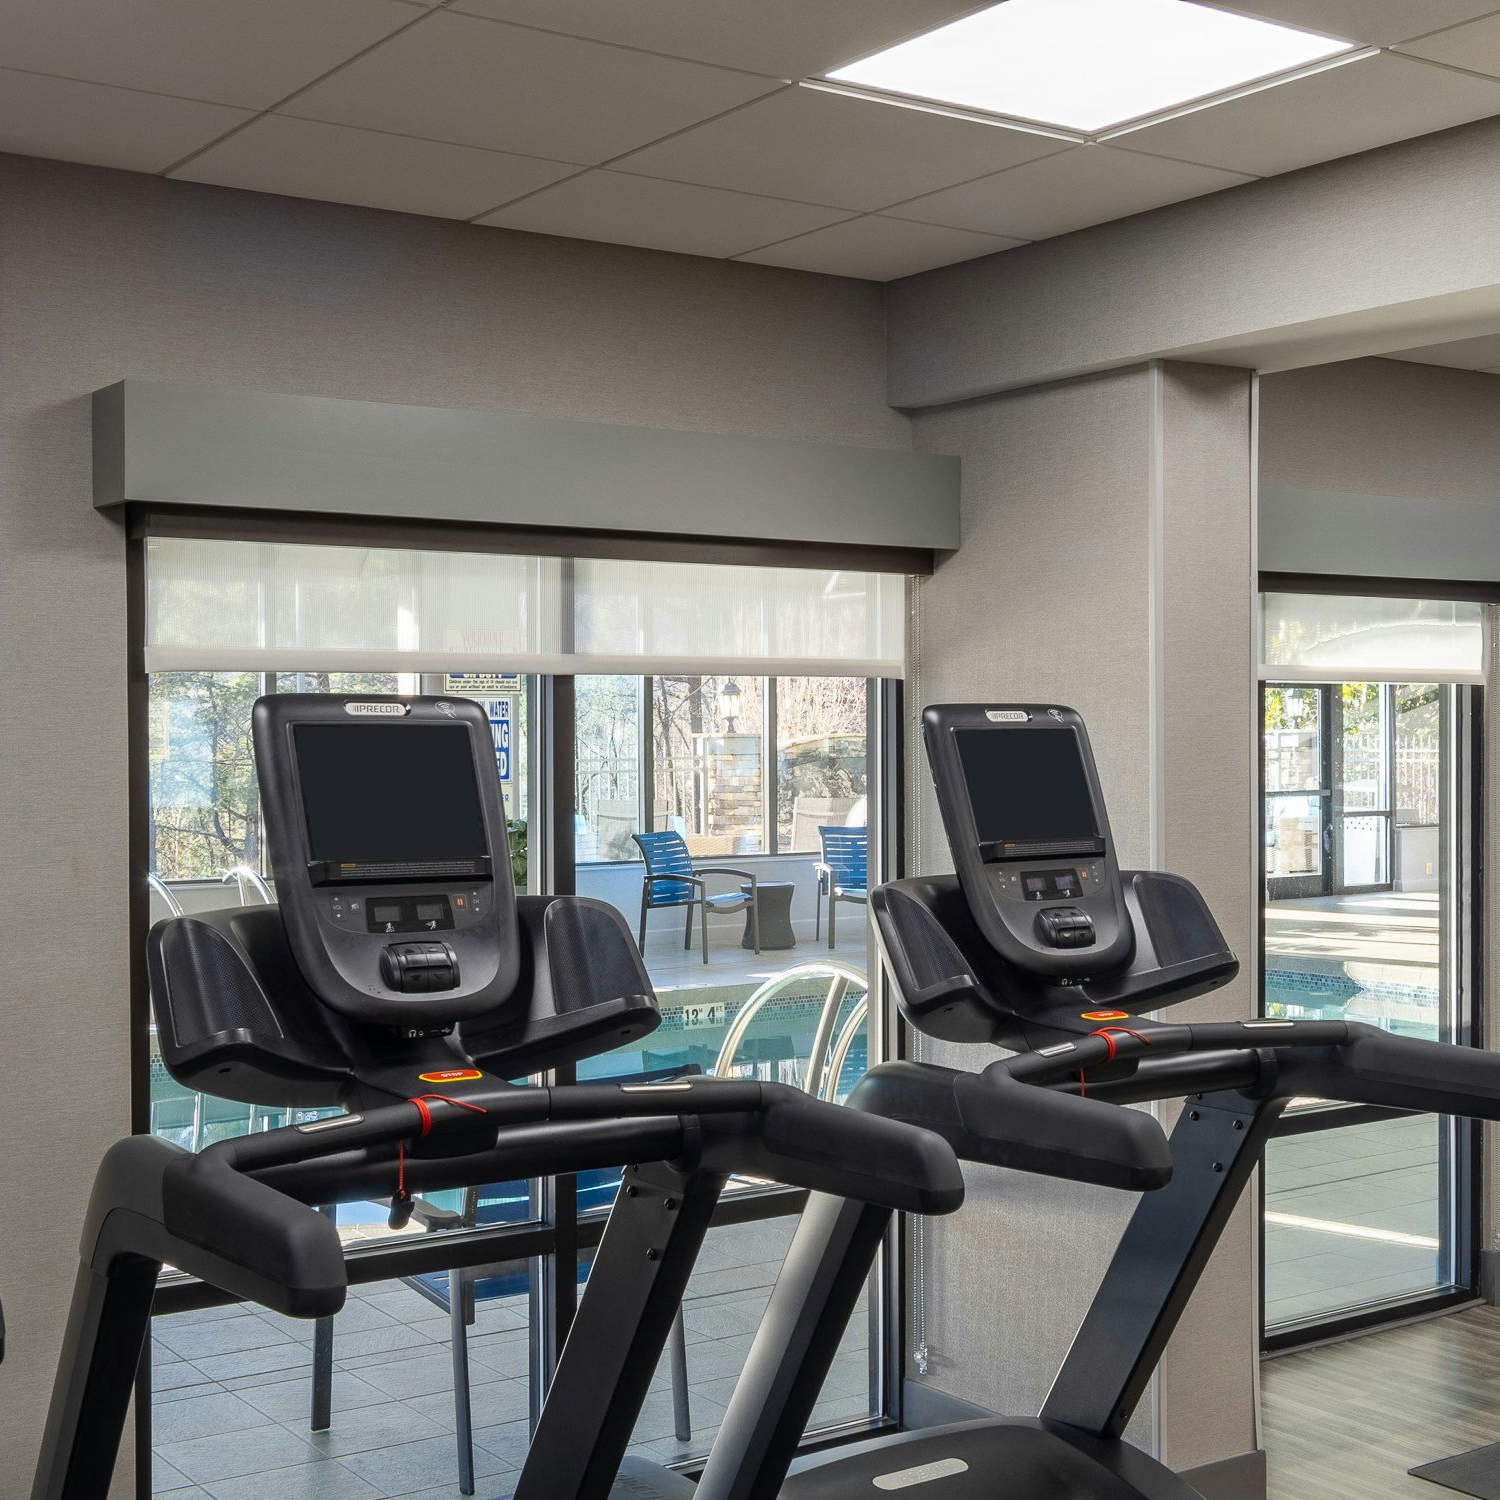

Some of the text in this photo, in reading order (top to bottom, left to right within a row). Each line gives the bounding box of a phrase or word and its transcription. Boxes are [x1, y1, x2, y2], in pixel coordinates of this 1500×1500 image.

[359, 705, 400, 714] PRECOR
[489, 701, 509, 718] WATER
[996, 712, 1025, 720] PRECOR
